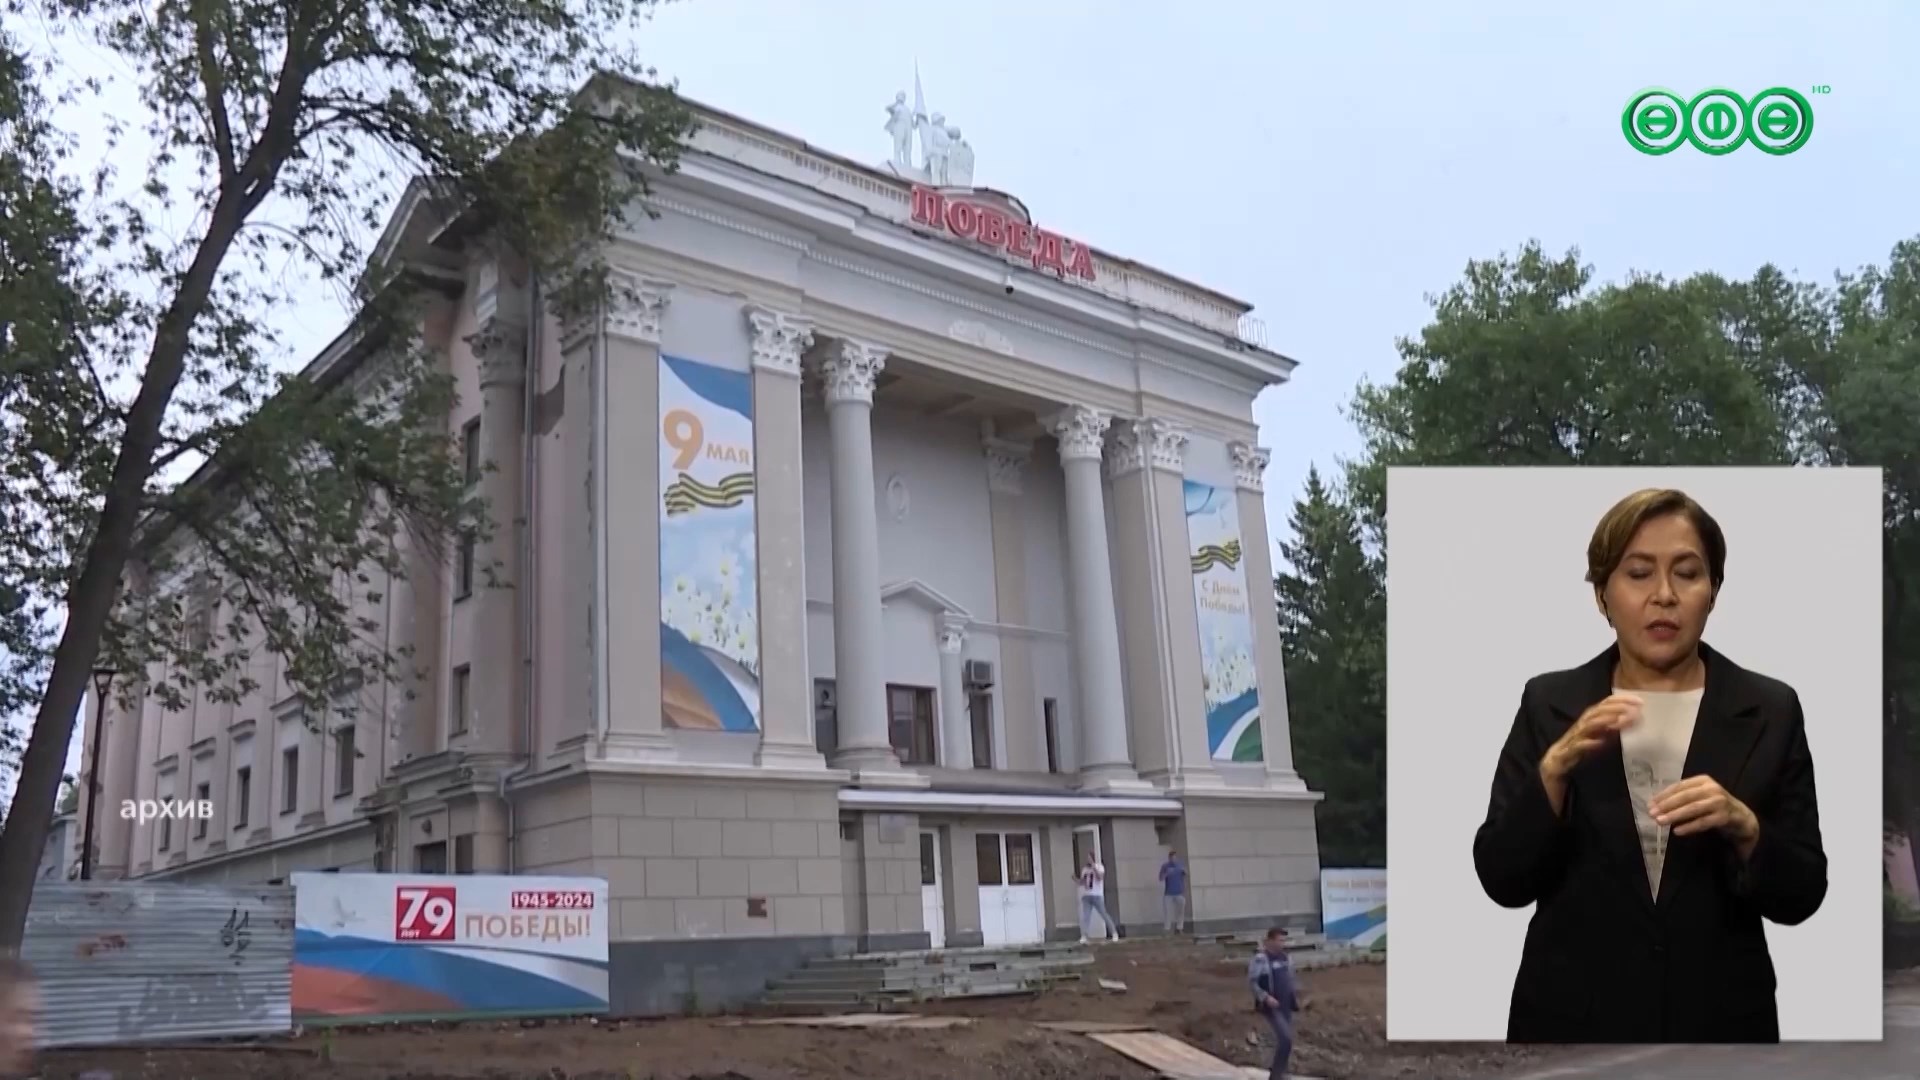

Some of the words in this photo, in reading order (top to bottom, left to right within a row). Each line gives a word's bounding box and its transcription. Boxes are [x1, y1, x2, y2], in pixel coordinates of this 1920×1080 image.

[911, 184, 1096, 282] ПОБЕДА
[663, 409, 704, 470] 9
[706, 443, 750, 466] МАЯ
[399, 889, 454, 937] 79
[512, 893, 593, 908] 1945-2024
[465, 914, 591, 942] ПОБЕДЫ!
